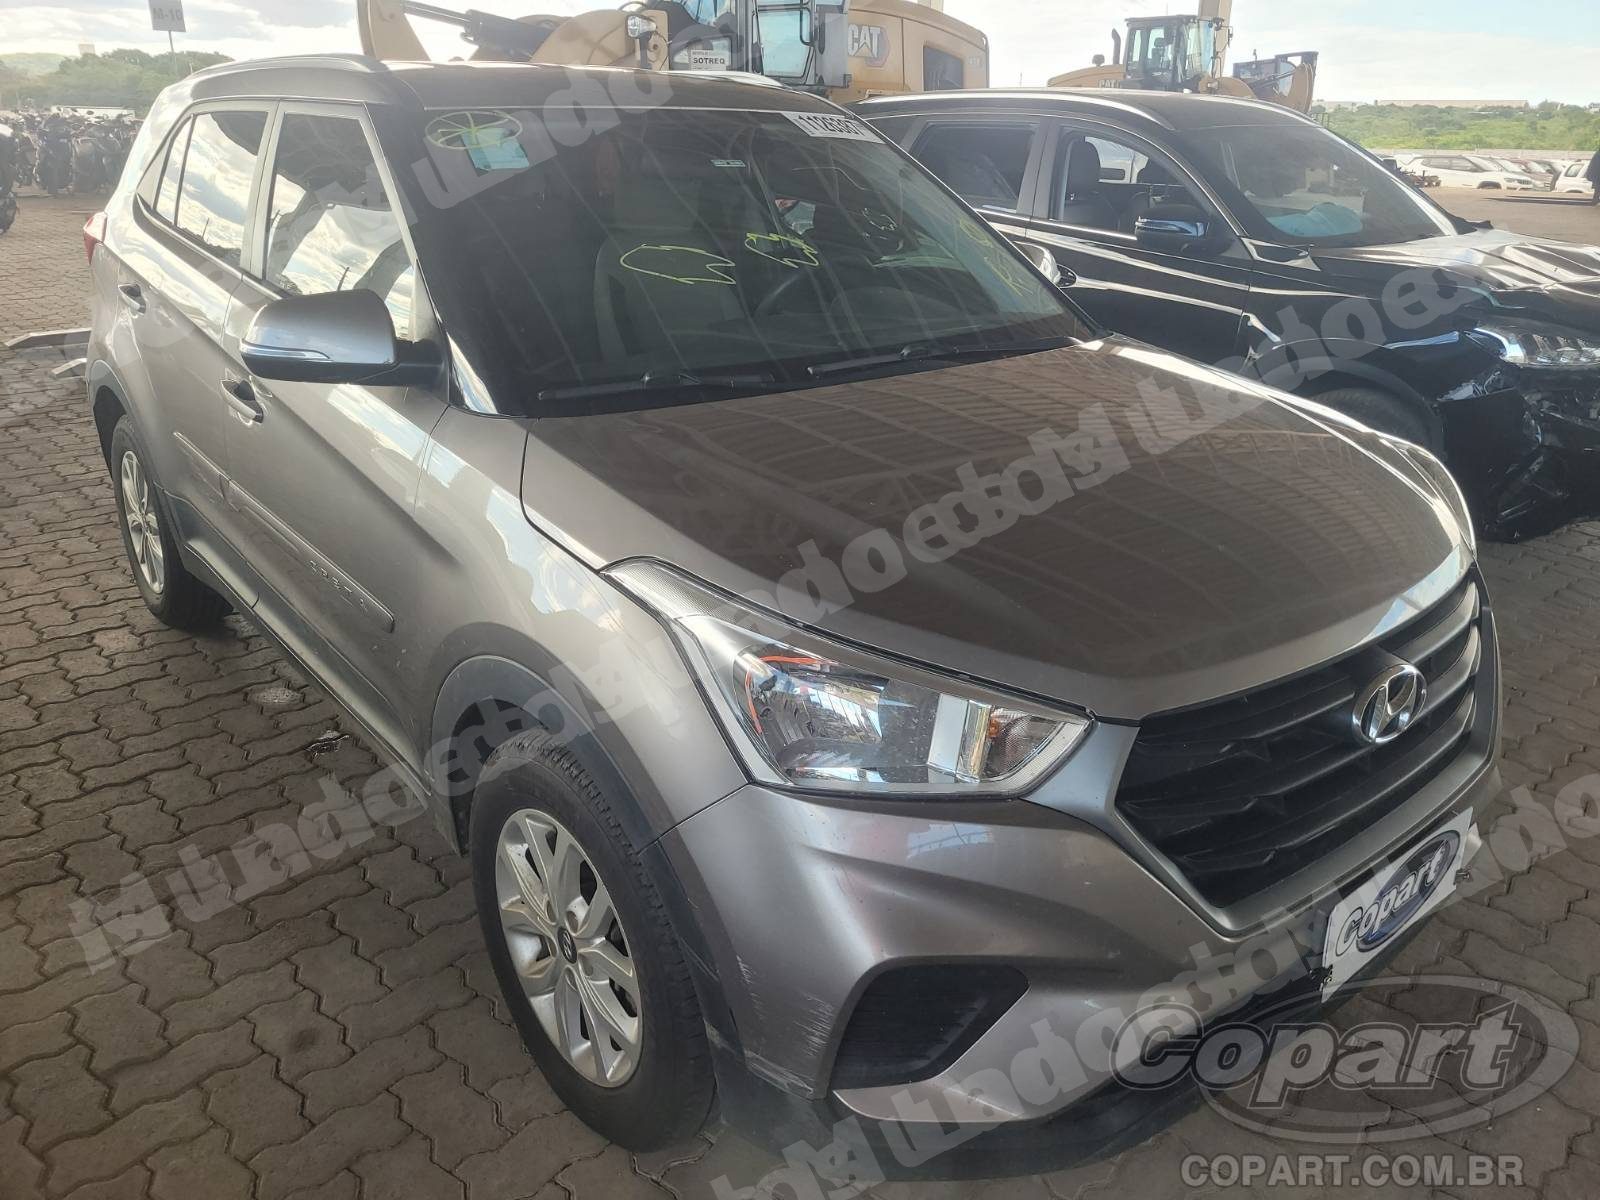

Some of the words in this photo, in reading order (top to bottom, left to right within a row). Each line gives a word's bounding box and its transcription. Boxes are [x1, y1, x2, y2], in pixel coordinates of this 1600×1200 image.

[847, 23, 881, 57] CAT
[693, 57, 725, 65] SOTREQ
[1335, 839, 1449, 957] Copart
